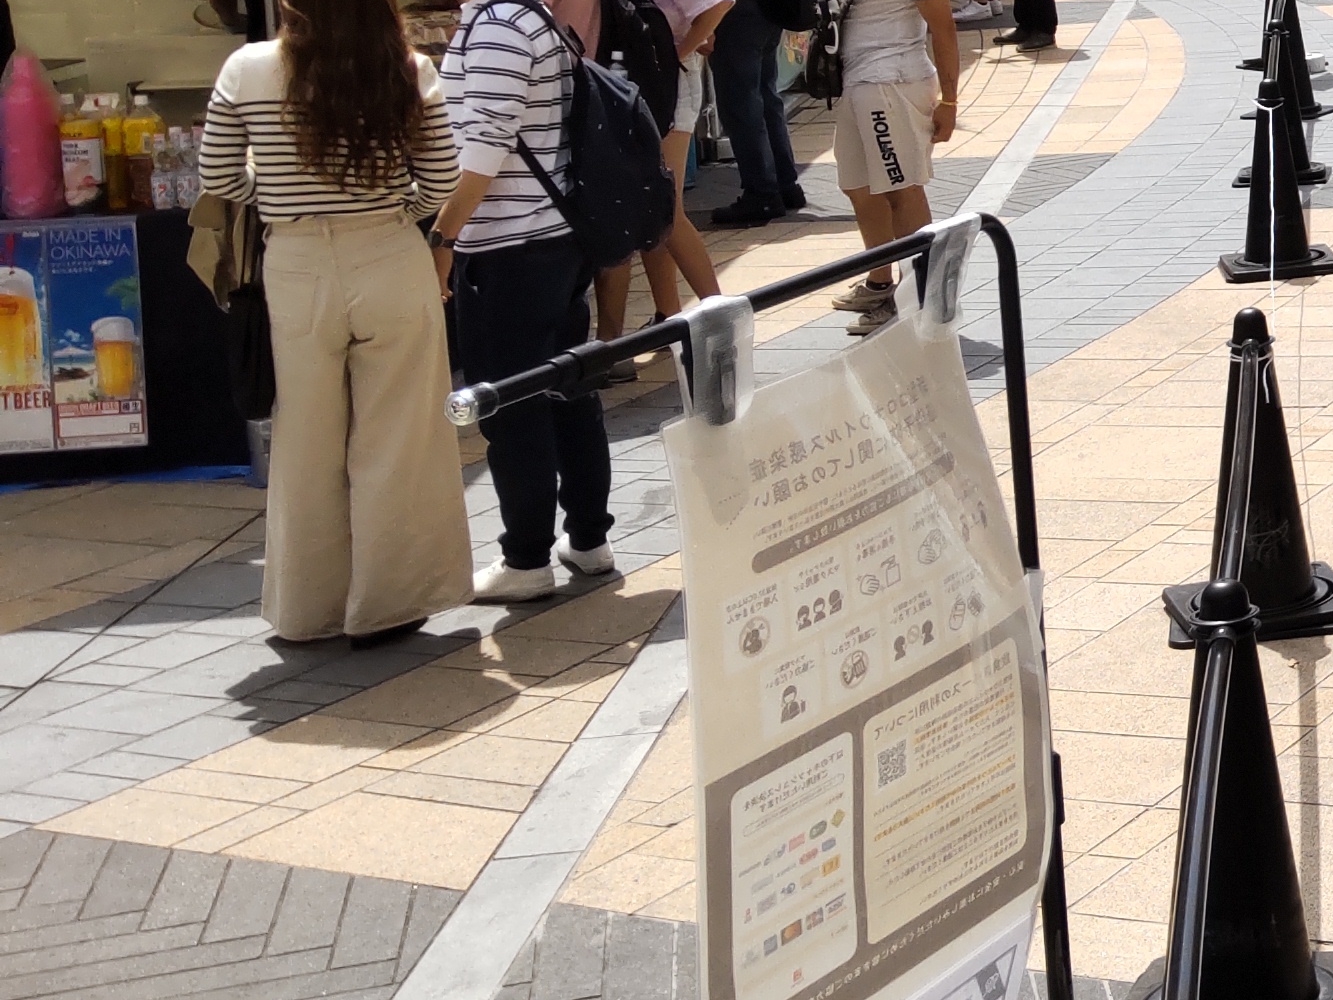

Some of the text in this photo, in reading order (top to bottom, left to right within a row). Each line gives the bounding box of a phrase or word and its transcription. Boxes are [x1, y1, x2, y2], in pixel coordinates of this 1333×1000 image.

[870, 109, 905, 186] HOLLISTER
[49, 228, 122, 244] MADE IN
[49, 242, 132, 260] OKINAWA
[14, 390, 51, 410] BEER
